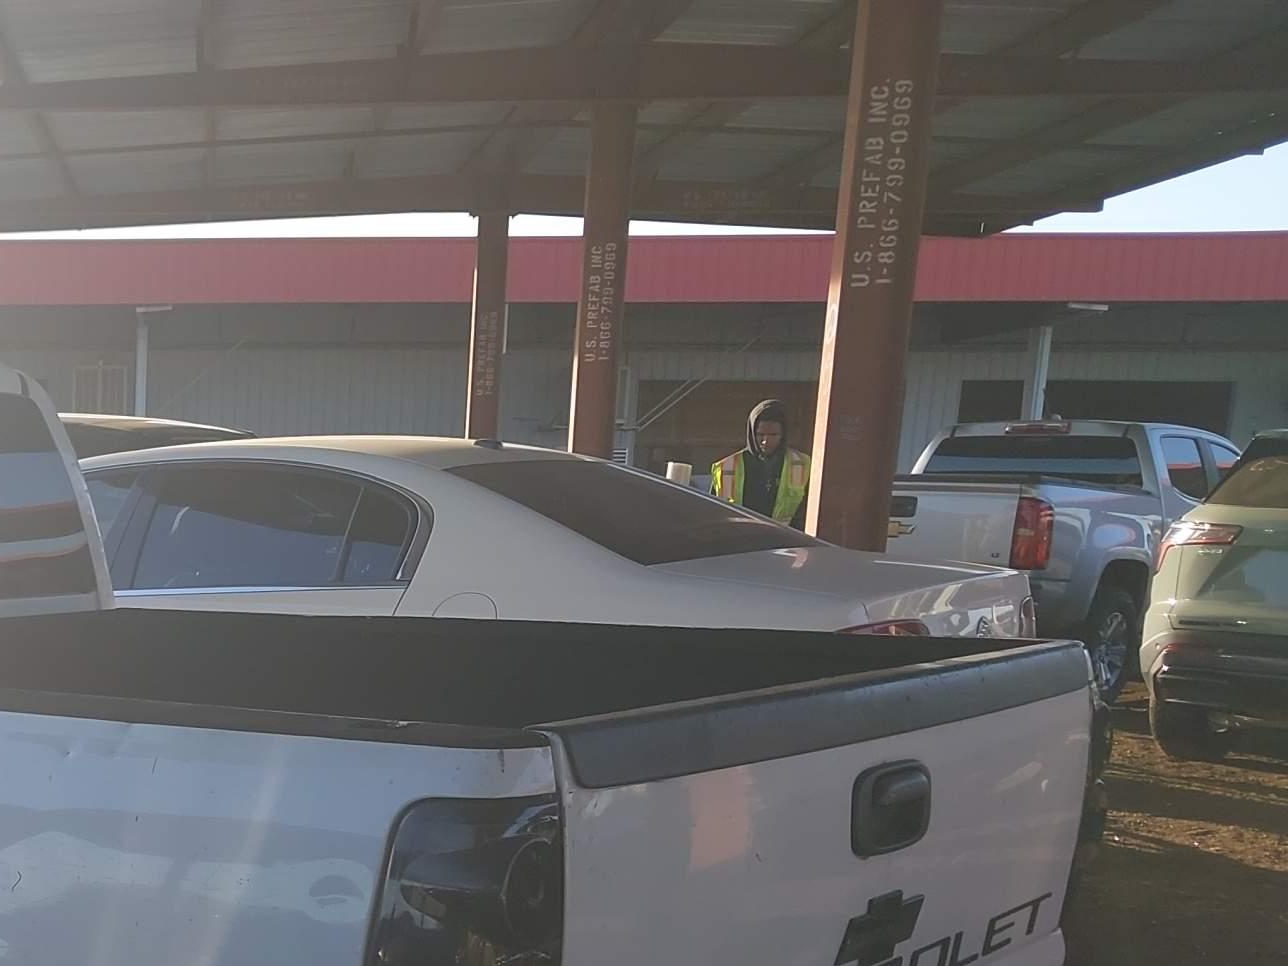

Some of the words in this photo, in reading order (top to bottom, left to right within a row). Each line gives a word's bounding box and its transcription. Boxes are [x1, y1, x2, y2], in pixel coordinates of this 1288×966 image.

[867, 77, 891, 123] INC.
[857, 136, 885, 230] PREFAB
[875, 79, 914, 285] 1-866-799-0969
[850, 242, 874, 288] U.S.
[587, 274, 602, 328] PREFAB
